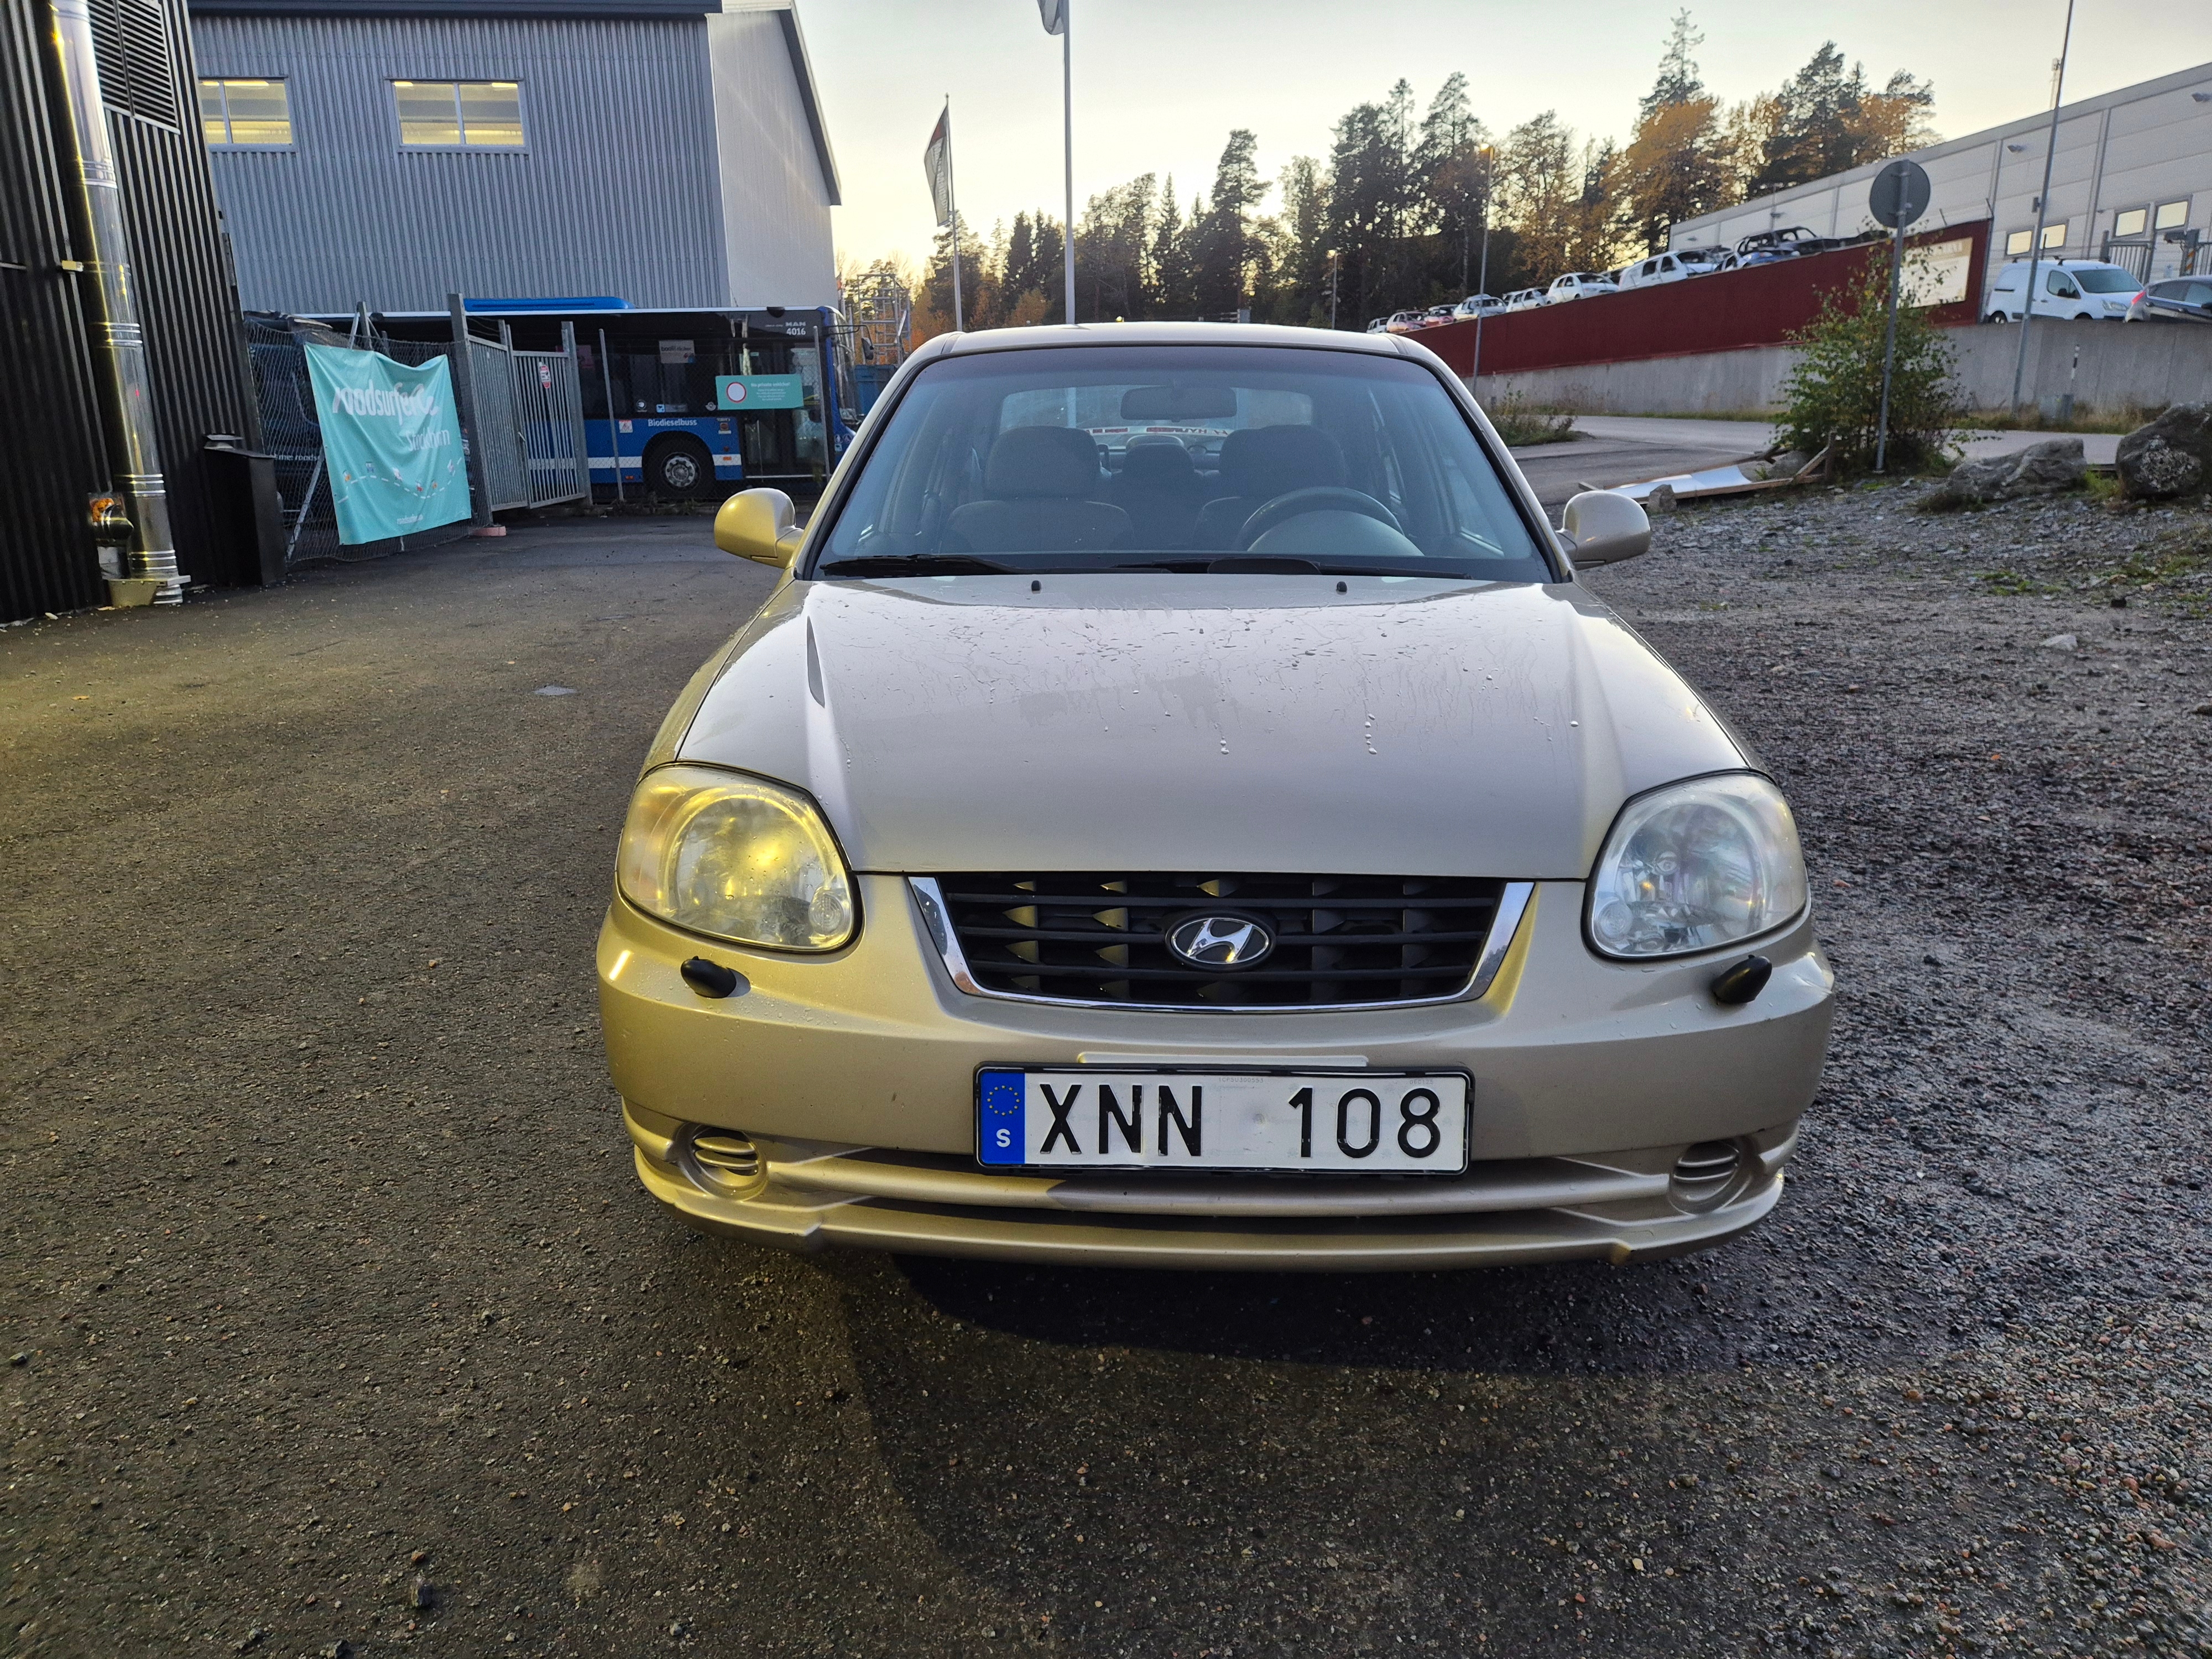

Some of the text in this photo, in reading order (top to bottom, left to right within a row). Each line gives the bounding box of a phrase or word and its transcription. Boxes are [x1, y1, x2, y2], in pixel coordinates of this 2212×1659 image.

[996, 1128, 1011, 1147] S
[1040, 1083, 1441, 1159] XNN 108
